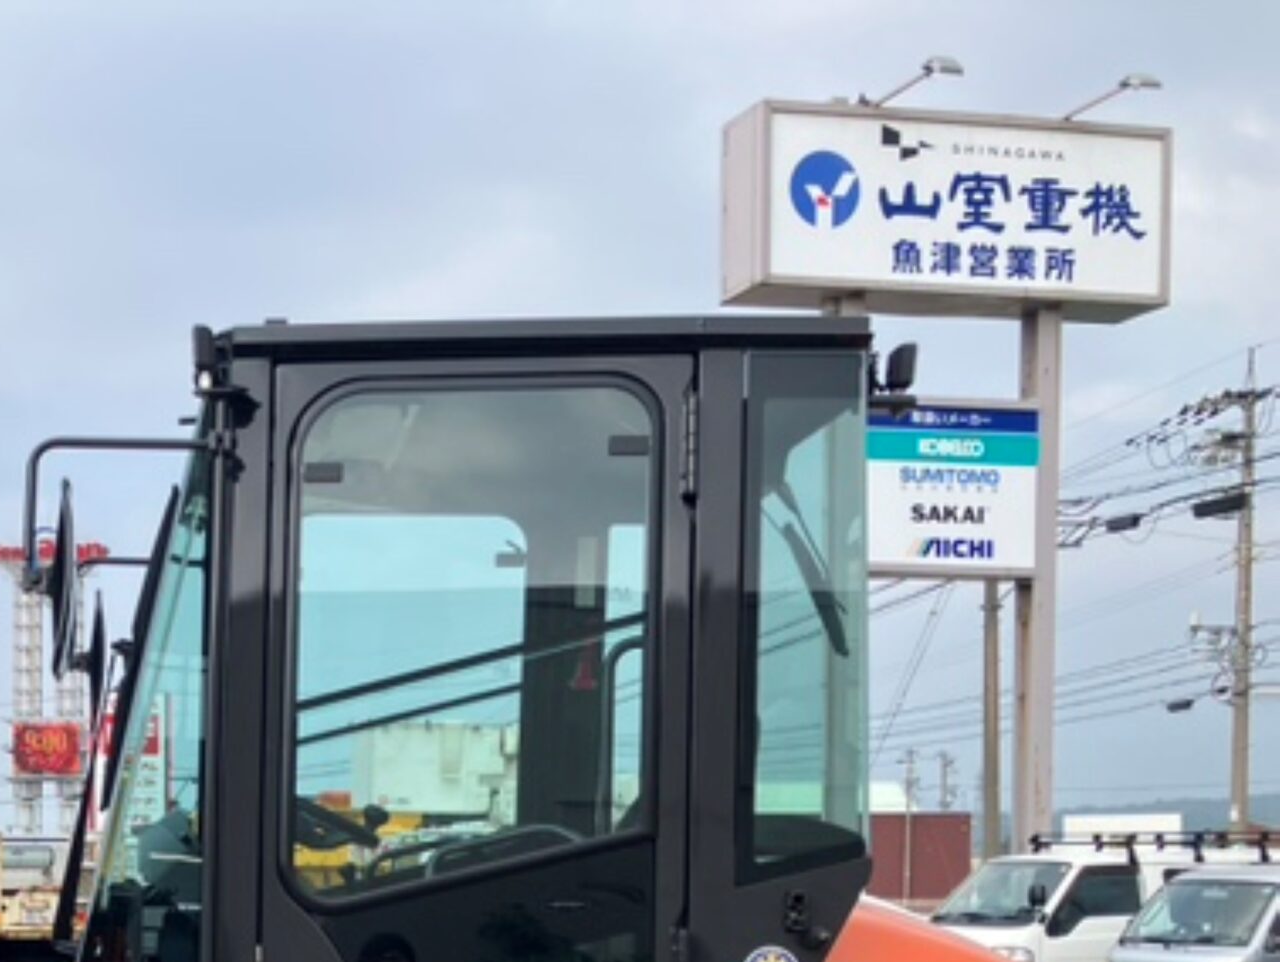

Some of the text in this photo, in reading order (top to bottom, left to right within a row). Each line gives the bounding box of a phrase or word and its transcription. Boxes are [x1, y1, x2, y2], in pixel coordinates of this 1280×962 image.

[952, 142, 1066, 161] SHINAGAWA
[878, 171, 1148, 240] 山室重機
[891, 238, 1076, 283] 魚津営業所
[910, 502, 985, 524] SAKAI
[916, 536, 994, 559] AICHI
